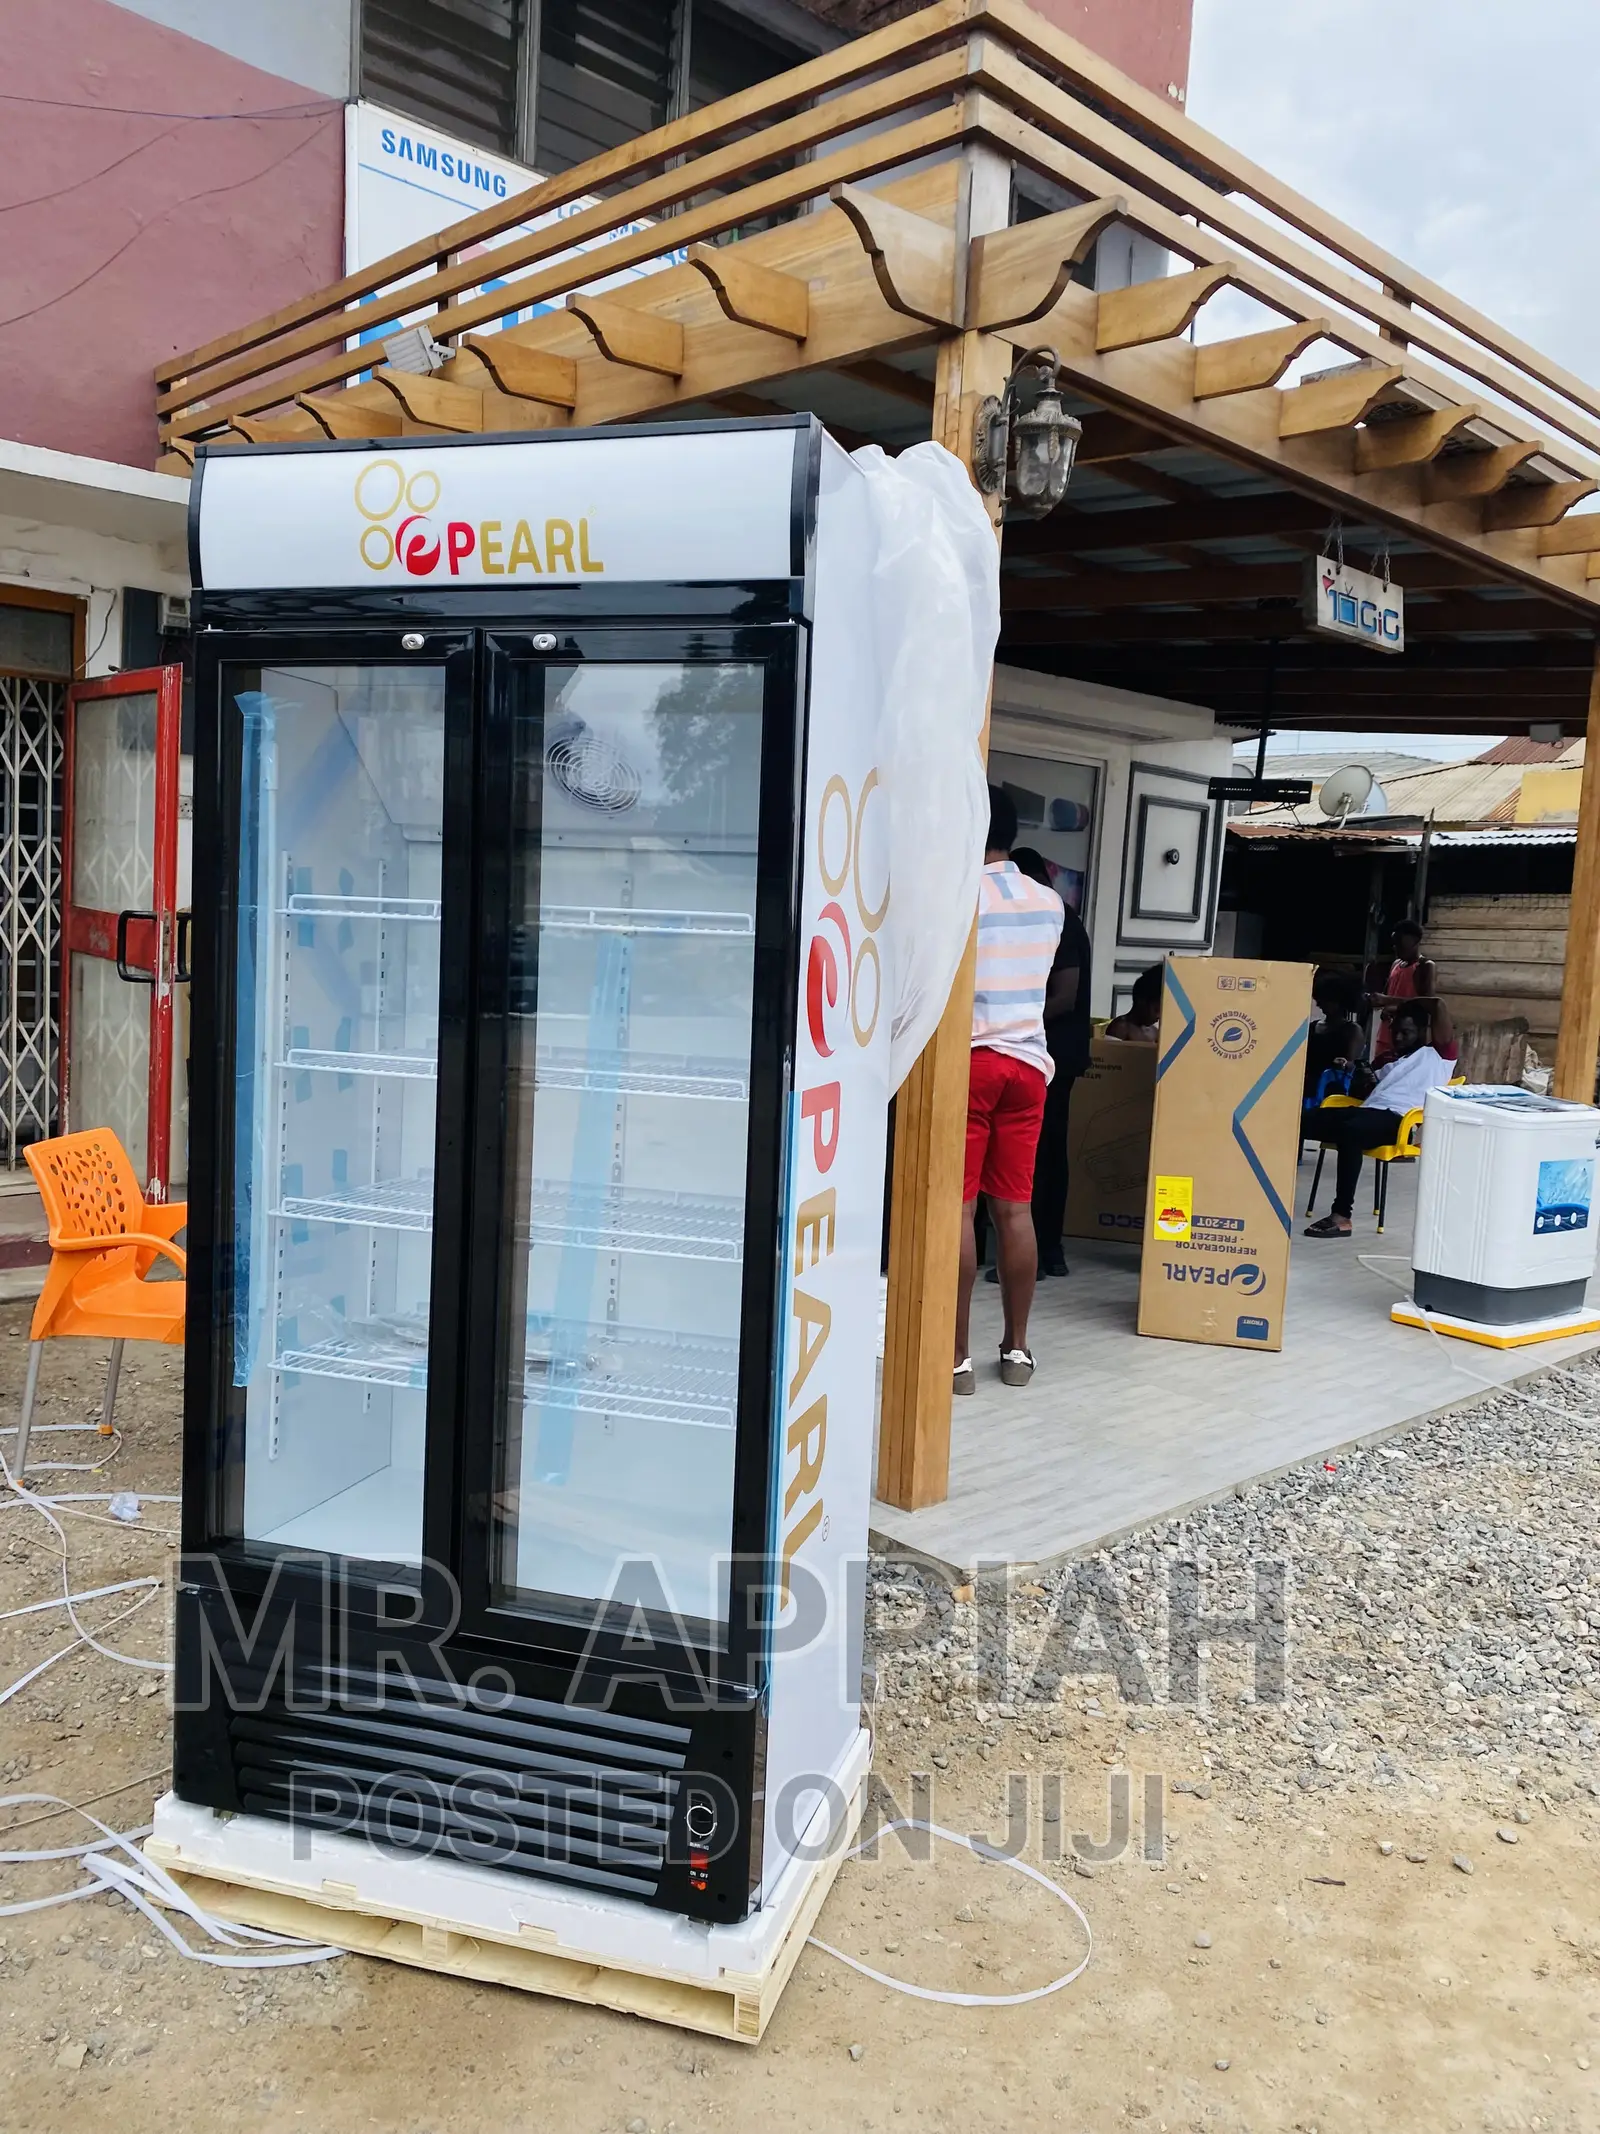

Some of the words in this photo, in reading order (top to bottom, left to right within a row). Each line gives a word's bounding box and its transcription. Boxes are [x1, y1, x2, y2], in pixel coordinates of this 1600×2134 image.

[381, 128, 507, 198] SAMSUNG
[1206, 1037, 1258, 1060] ECO-FRIENDLY
[1197, 1217, 1239, 1230] PF-20T
[1175, 1240, 1258, 1256] REFRIGERATOR
